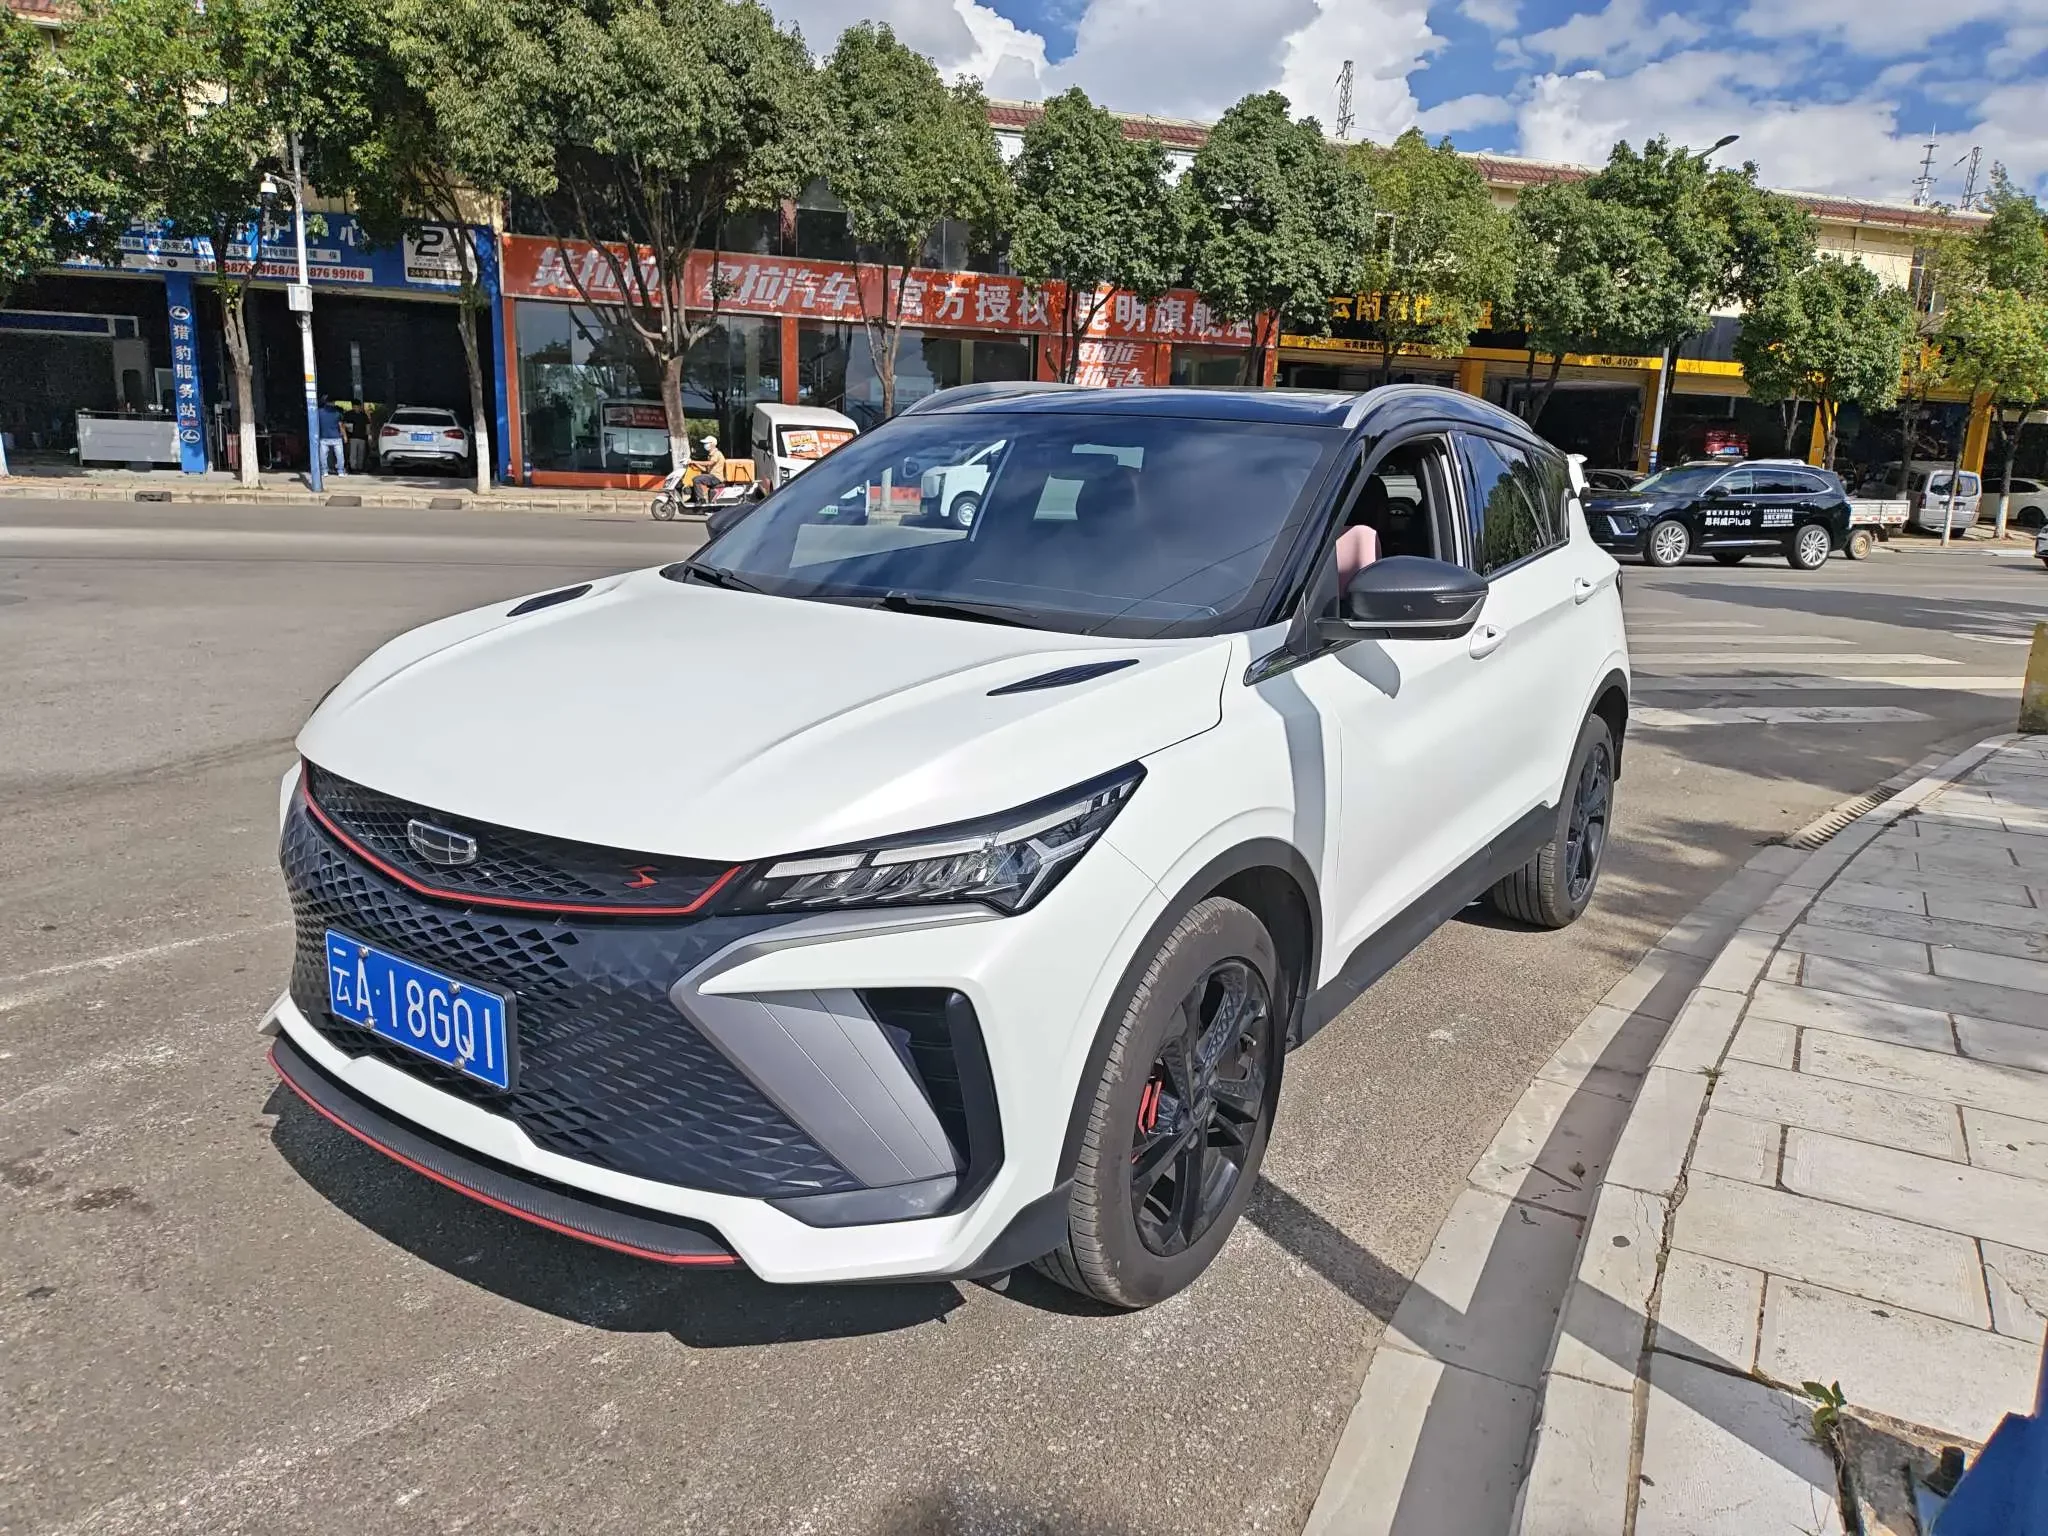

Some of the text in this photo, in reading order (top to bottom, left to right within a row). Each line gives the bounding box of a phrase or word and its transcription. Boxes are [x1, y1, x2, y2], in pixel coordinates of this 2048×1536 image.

[891, 278, 1050, 327] 官方授权
[172, 324, 197, 418] 猎豹服务站
[1617, 357, 1639, 367] 4909
[1704, 517, 1751, 526] 昂科威Plus
